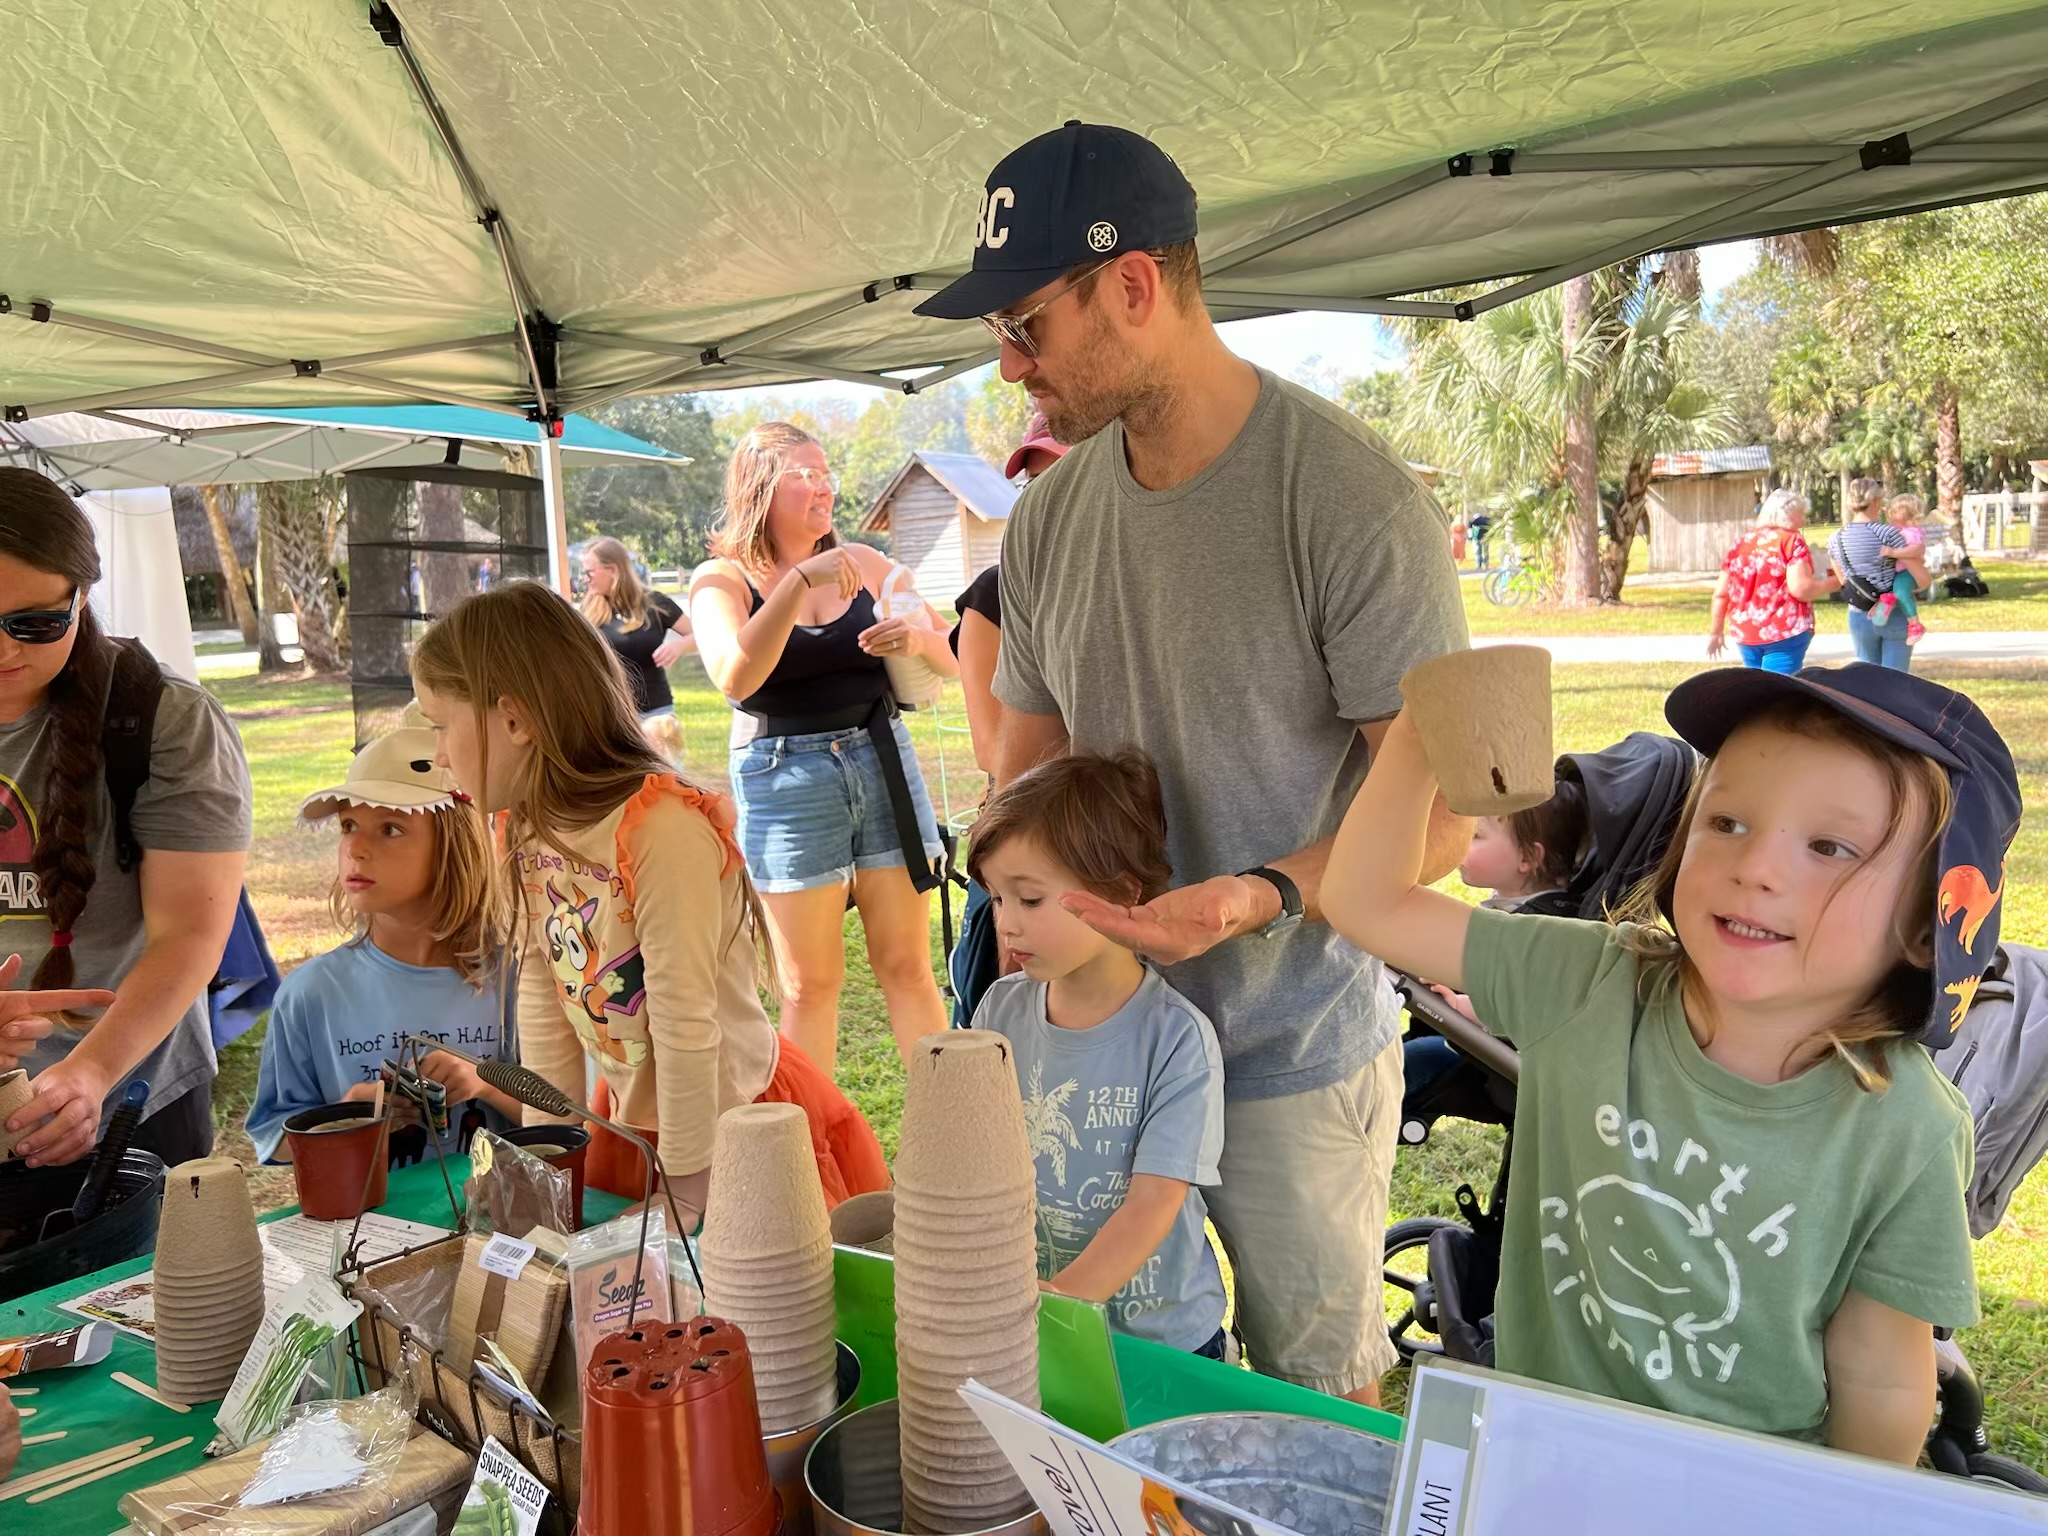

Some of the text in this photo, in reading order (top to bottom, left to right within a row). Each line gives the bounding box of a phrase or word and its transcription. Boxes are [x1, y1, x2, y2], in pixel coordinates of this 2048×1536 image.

[0, 871, 48, 909] AR
[338, 1034, 385, 1056] Hoof
[392, 1030, 409, 1049] it
[418, 1030, 450, 1047] for
[1084, 1105, 1139, 1129] ANNU
[1095, 1139, 1111, 1156] AT
[1105, 1171, 1131, 1191] The
[1595, 1104, 1797, 1257] earth
[480, 1451, 545, 1507] SNAP PEA SEEDS
